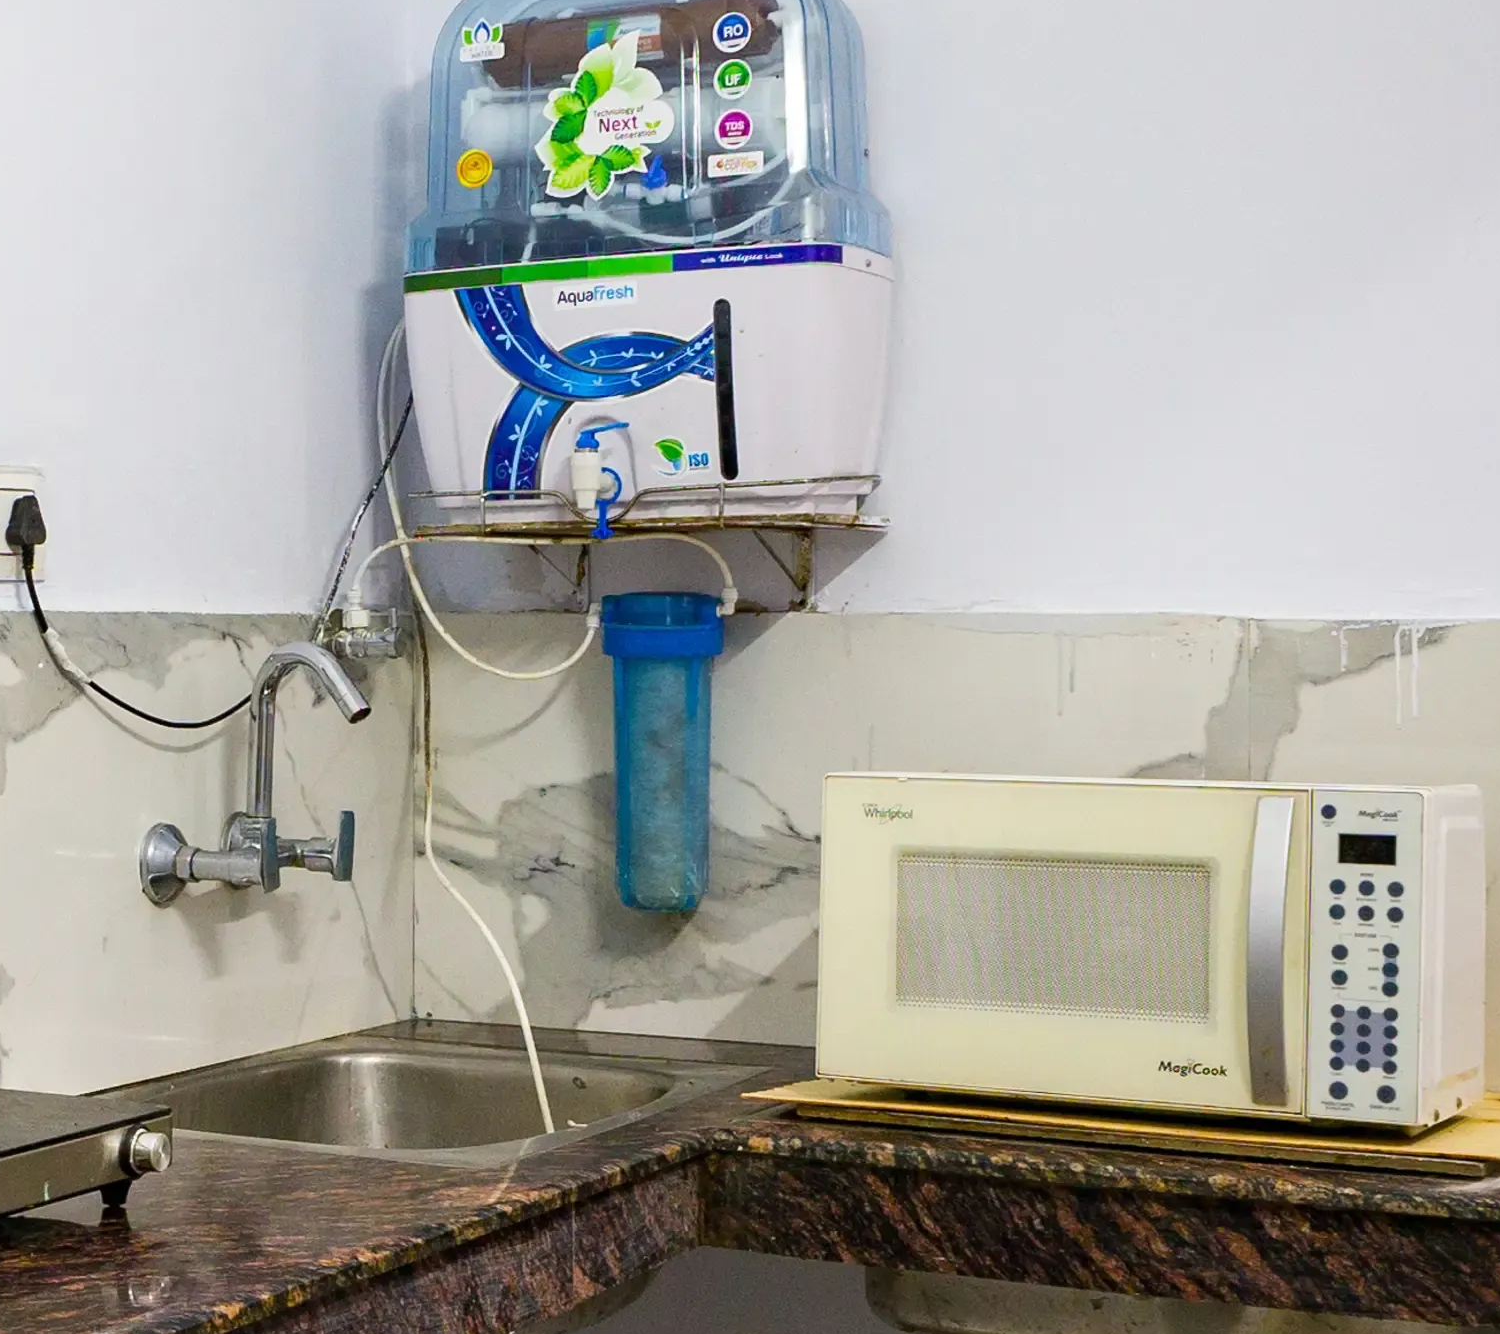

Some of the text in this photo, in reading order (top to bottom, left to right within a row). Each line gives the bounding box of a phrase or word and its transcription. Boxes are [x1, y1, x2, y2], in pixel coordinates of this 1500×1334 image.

[723, 23, 744, 39] RO
[725, 73, 743, 86] UF
[594, 105, 645, 118] Technology of
[599, 115, 639, 133] Next
[724, 120, 745, 131] TDS
[614, 130, 657, 140] Generation
[718, 253, 763, 264] Unique
[688, 452, 709, 467] ISO
[863, 807, 913, 822] Whirlpool
[1158, 1060, 1228, 1077] MagiCook
